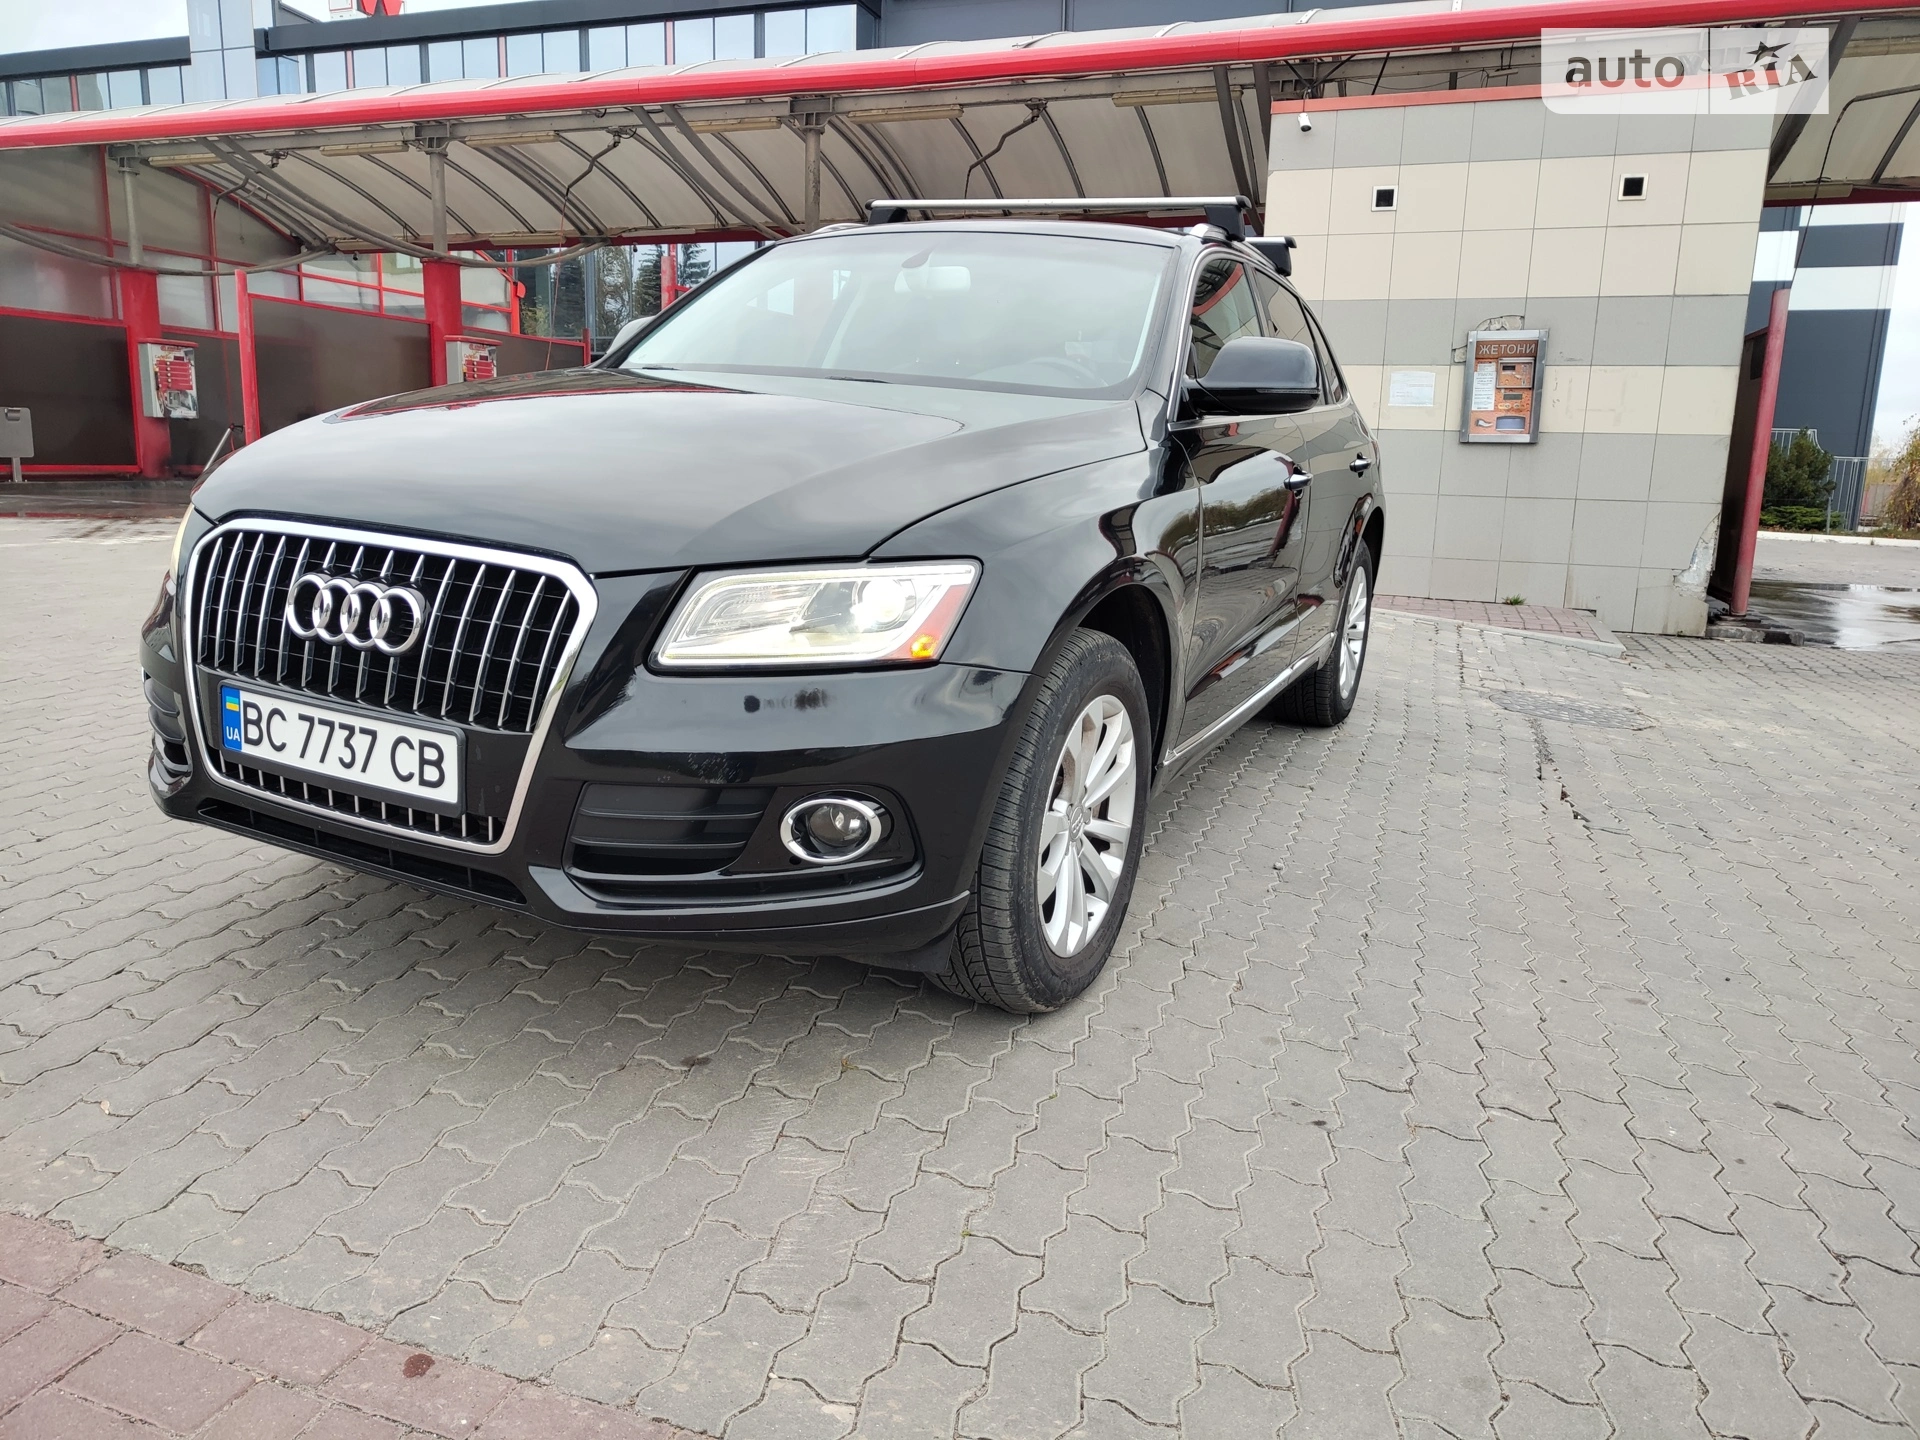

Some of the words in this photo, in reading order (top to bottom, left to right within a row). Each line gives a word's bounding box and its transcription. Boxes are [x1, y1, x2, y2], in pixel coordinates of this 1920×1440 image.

[1479, 344, 1535, 355] ЖЕТОНИ
[226, 726, 241, 742] UA
[243, 700, 287, 752] BC
[298, 713, 377, 773] 7737
[390, 735, 445, 788] CB
